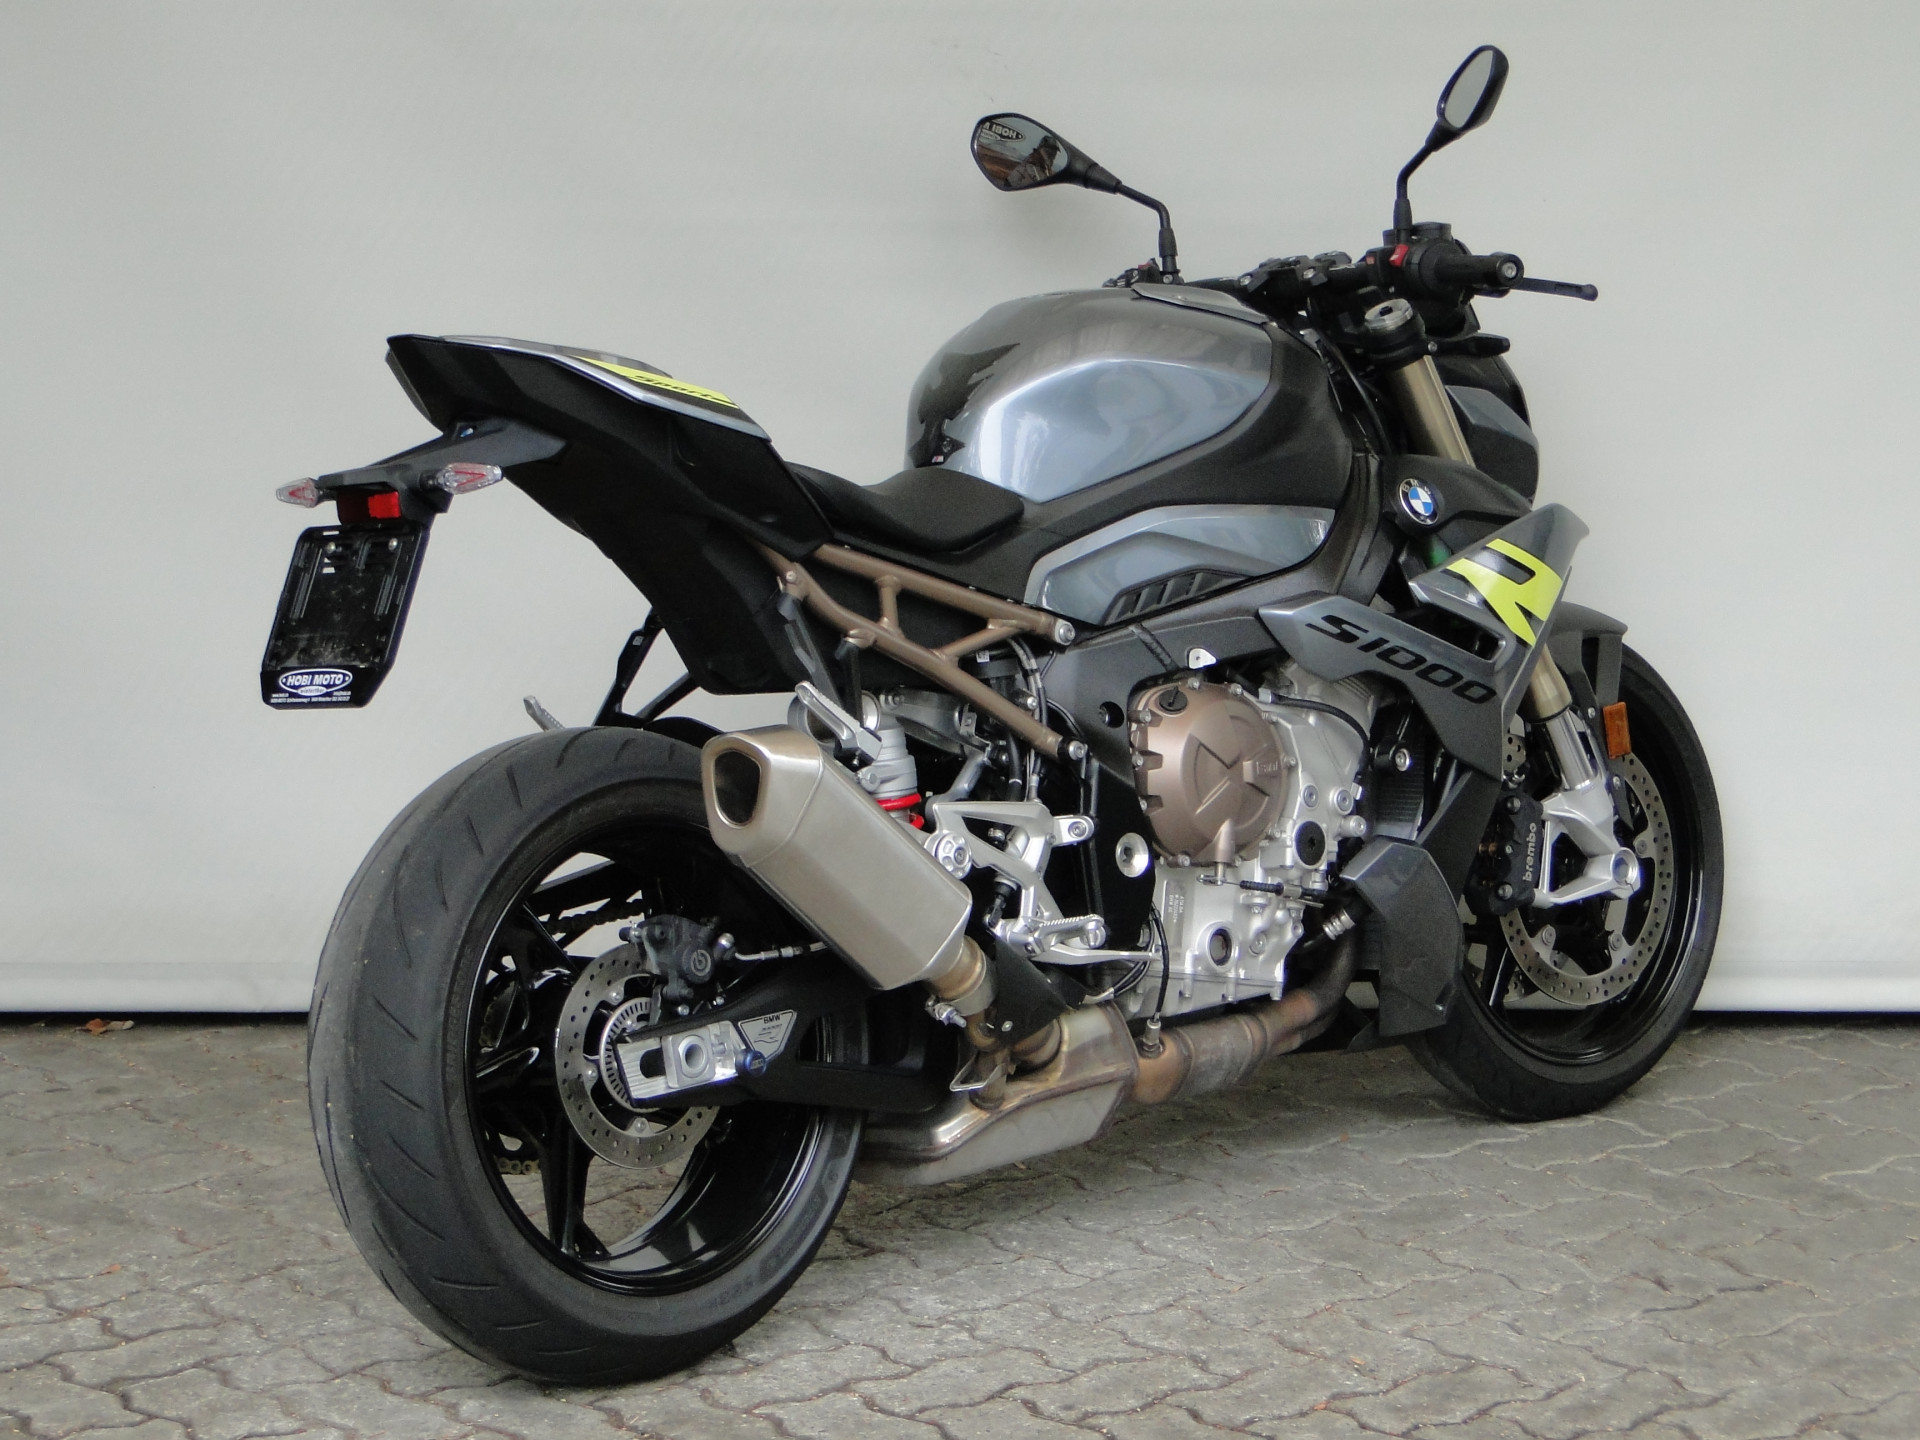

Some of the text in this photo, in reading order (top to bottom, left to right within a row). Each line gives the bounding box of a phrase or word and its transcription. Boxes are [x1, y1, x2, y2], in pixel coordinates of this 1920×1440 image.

[1305, 614, 1497, 704] S1000
[286, 674, 343, 686] HOBI MOTO
[1522, 822, 1537, 881] brembo
[763, 1014, 781, 1024] BMW
